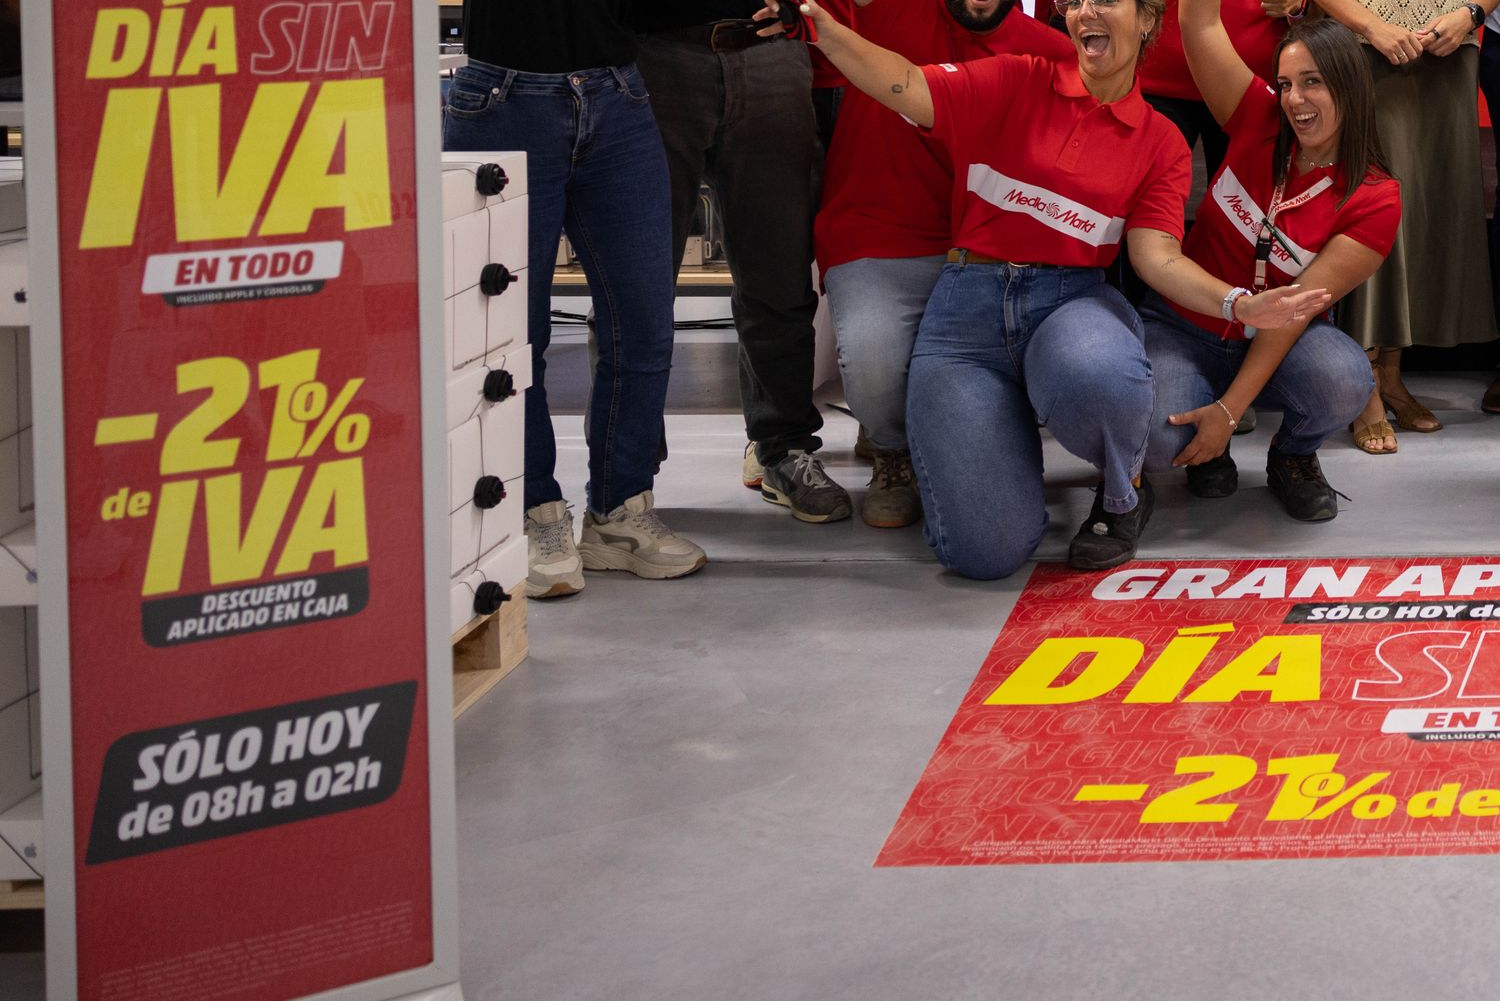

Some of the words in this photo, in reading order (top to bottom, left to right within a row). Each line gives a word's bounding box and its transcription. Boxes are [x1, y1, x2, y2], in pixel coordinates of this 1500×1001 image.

[251, 1, 394, 75] SIN
[79, 77, 393, 249] IVA
[1004, 188, 1047, 212] Media
[1055, 209, 1097, 234] Markt
[1224, 194, 1254, 227] Media
[175, 253, 220, 286] EN
[227, 248, 313, 281] TODO
[94, 349, 370, 475] -21%
[102, 486, 150, 521] de
[142, 457, 368, 596] IVA
[202, 579, 317, 614] DESCUENTO
[1091, 565, 1371, 601] GRAN
[167, 604, 270, 640] APLICADO
[272, 601, 299, 622] EN
[302, 593, 348, 618] CAJA
[1306, 602, 1391, 621] SÓLO
[1395, 604, 1471, 620] HOY
[984, 622, 1322, 705] DÍA
[1423, 711, 1481, 728] EN
[1425, 733, 1486, 741] INCLUIDO
[133, 716, 262, 791] SÓLO
[271, 703, 381, 762] HOY
[118, 795, 171, 841] de
[181, 780, 263, 830] 08h
[271, 785, 295, 809] a
[305, 756, 381, 803] 02h
[1072, 753, 1398, 823] -21%
